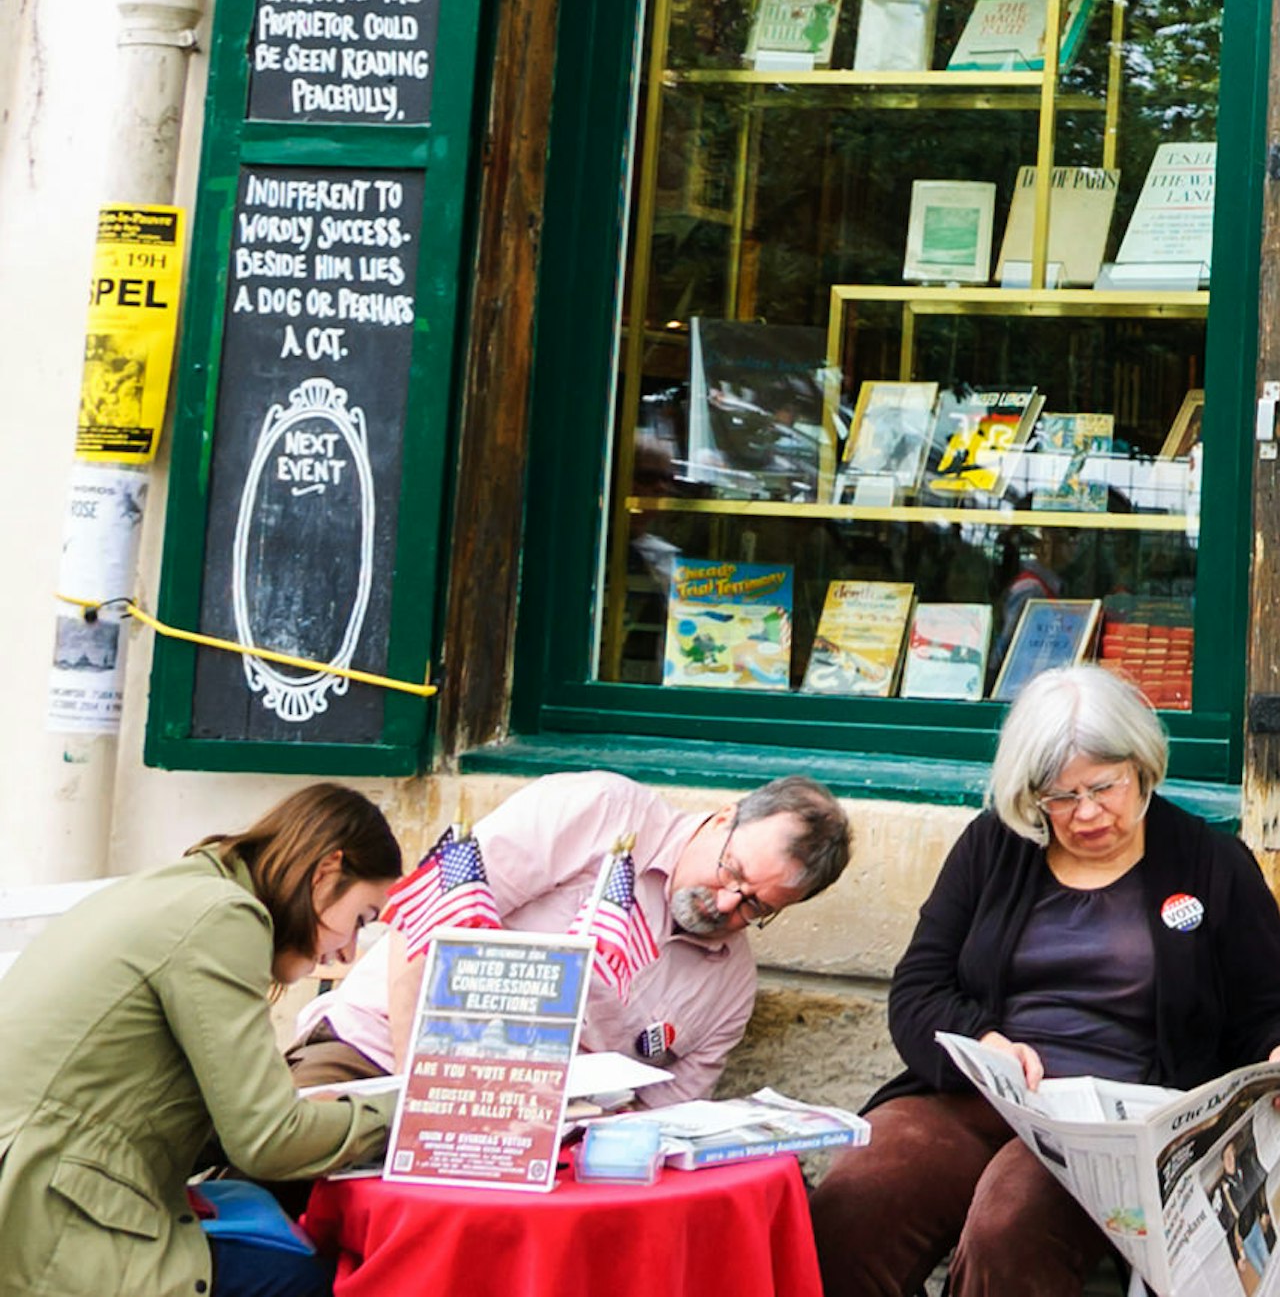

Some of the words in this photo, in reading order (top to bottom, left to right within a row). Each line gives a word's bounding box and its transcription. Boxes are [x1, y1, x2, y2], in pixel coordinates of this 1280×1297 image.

[245, 174, 372, 212] INDIFFERENT
[373, 180, 403, 212] TO
[129, 252, 166, 269] 19H
[89, 278, 168, 309] PEL
[284, 430, 340, 458] NEXT
[277, 455, 347, 485] EVENT
[1166, 900, 1201, 924] VOTE
[457, 960, 505, 976] UNITED
[509, 964, 561, 980] STATES
[452, 976, 558, 998] CONGRESSIONAL
[466, 993, 538, 1014] ELECTIONS
[1172, 1107, 1203, 1131] The
